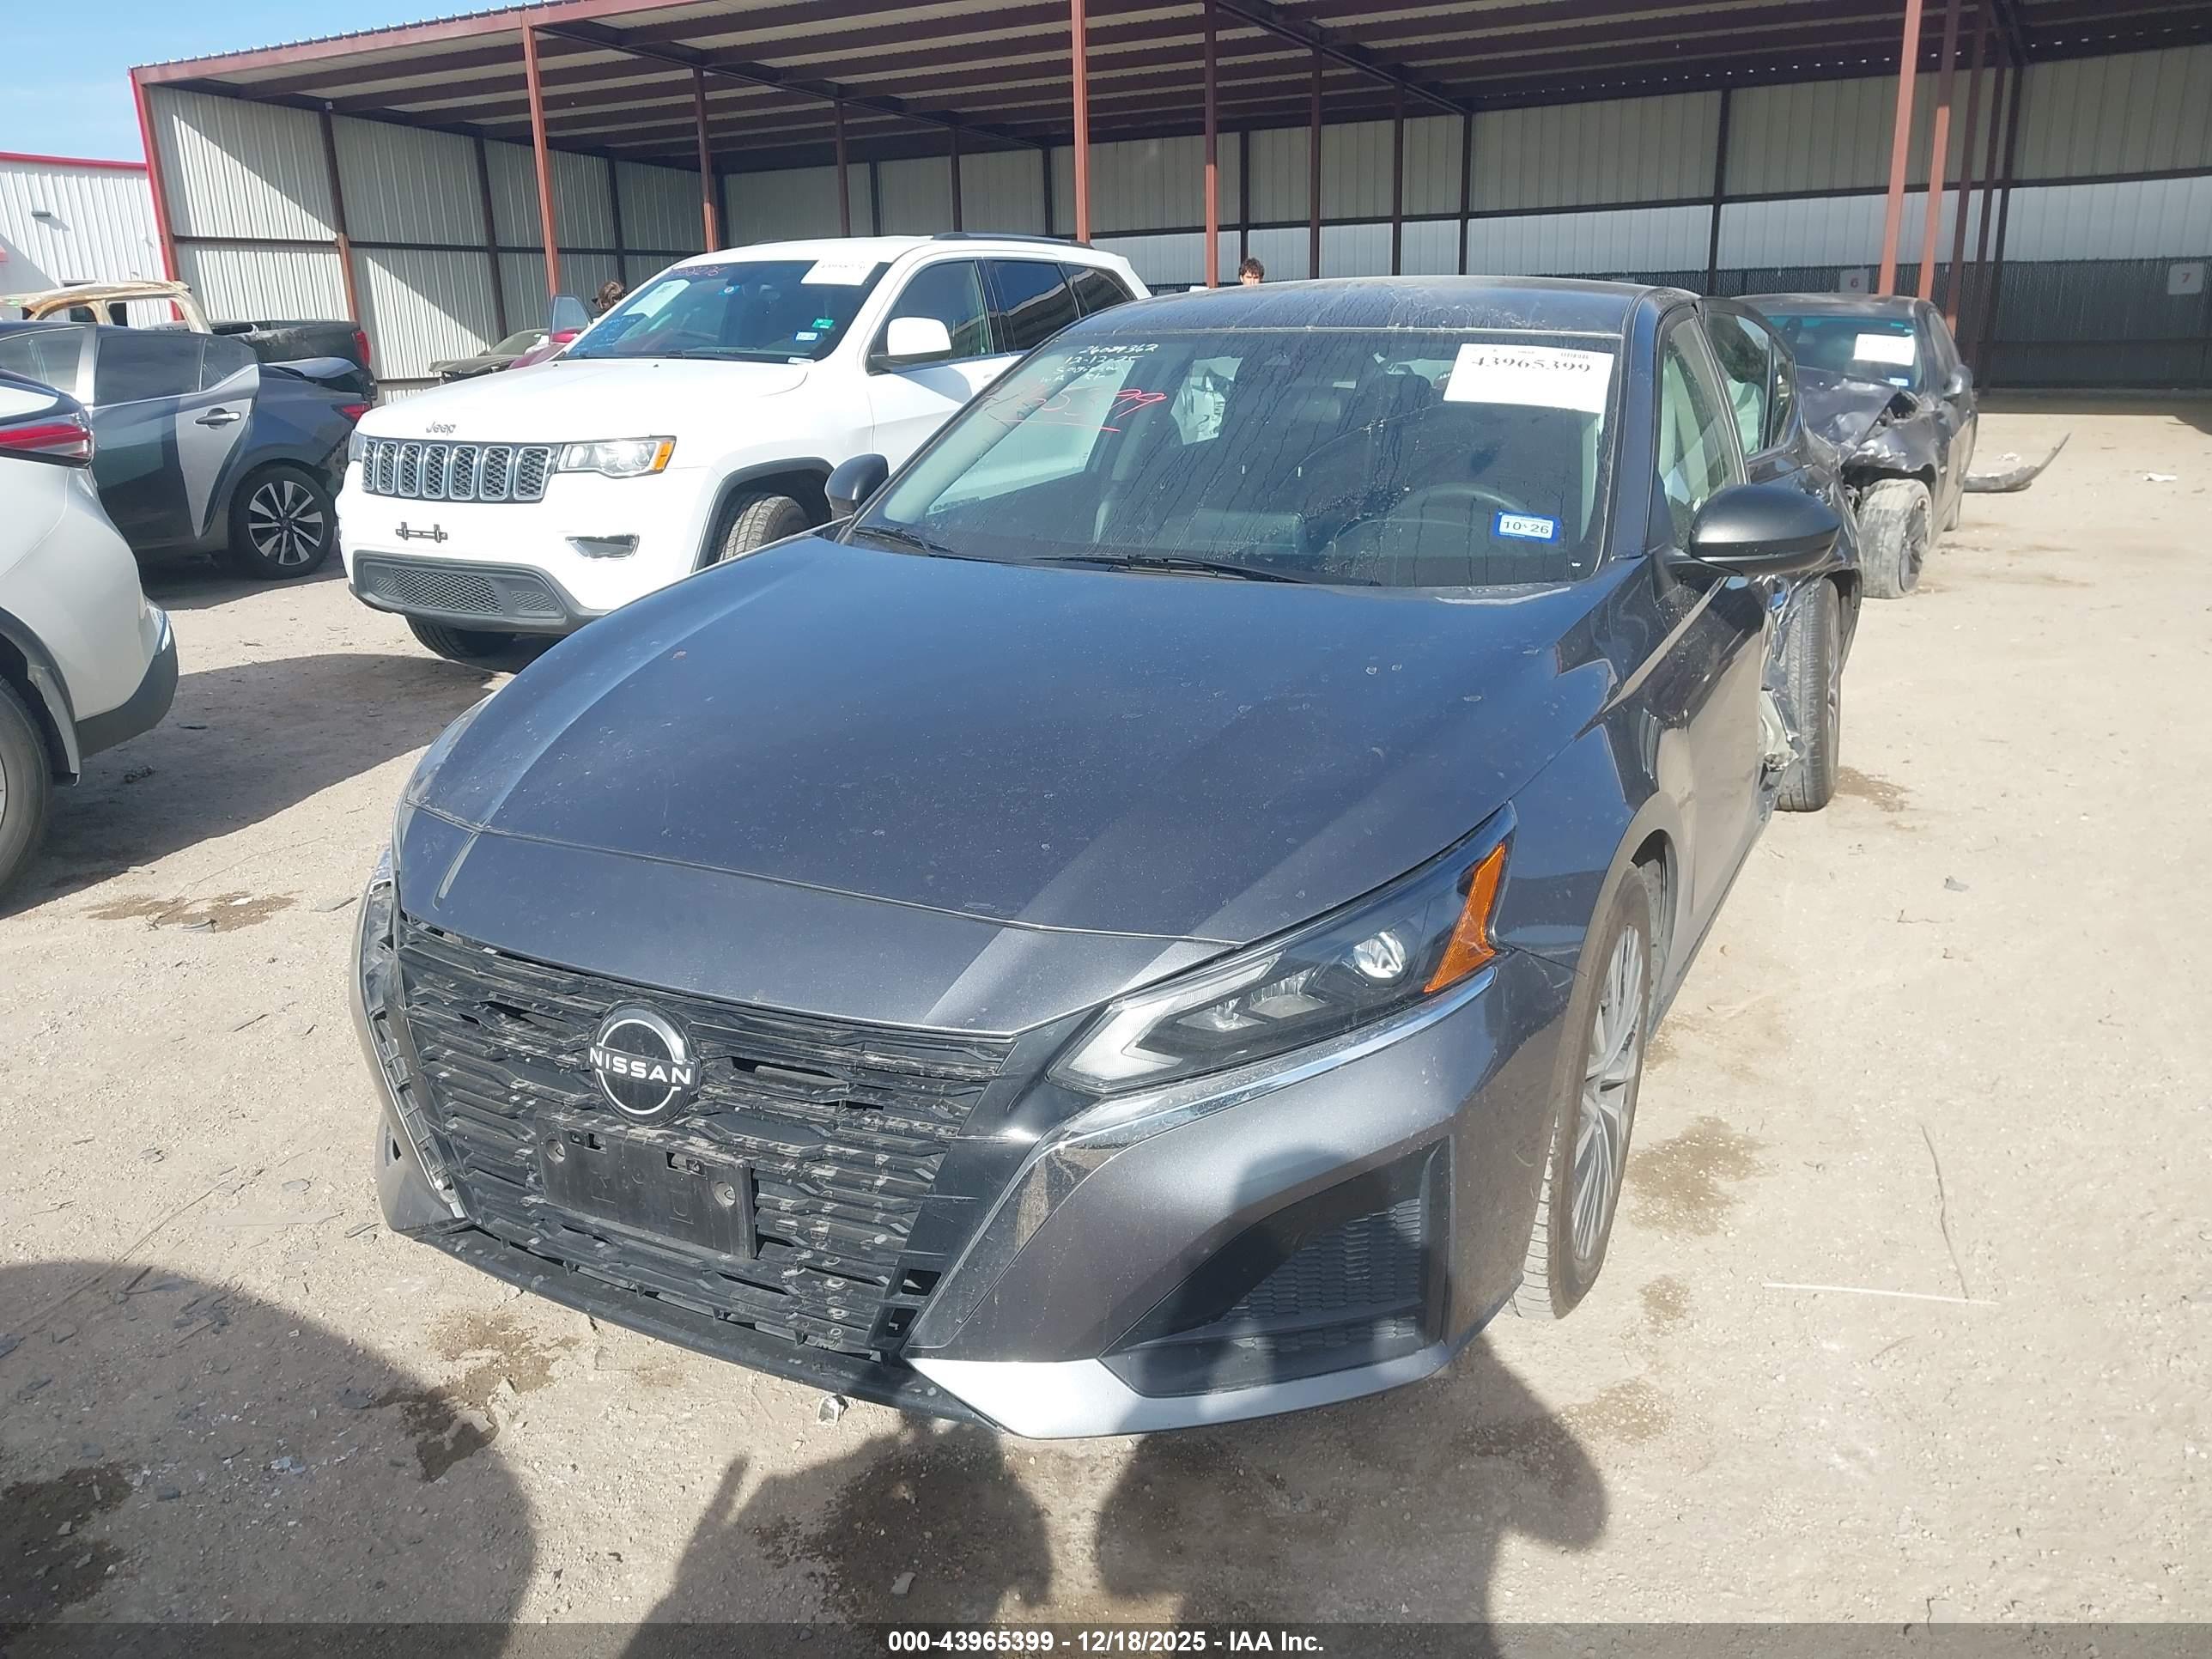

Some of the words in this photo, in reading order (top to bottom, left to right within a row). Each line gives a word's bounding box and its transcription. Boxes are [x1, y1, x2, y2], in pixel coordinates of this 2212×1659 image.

[1471, 356, 1591, 373] 43965399
[425, 420, 457, 437] Jeep
[589, 1046, 691, 1085] NISSAN
